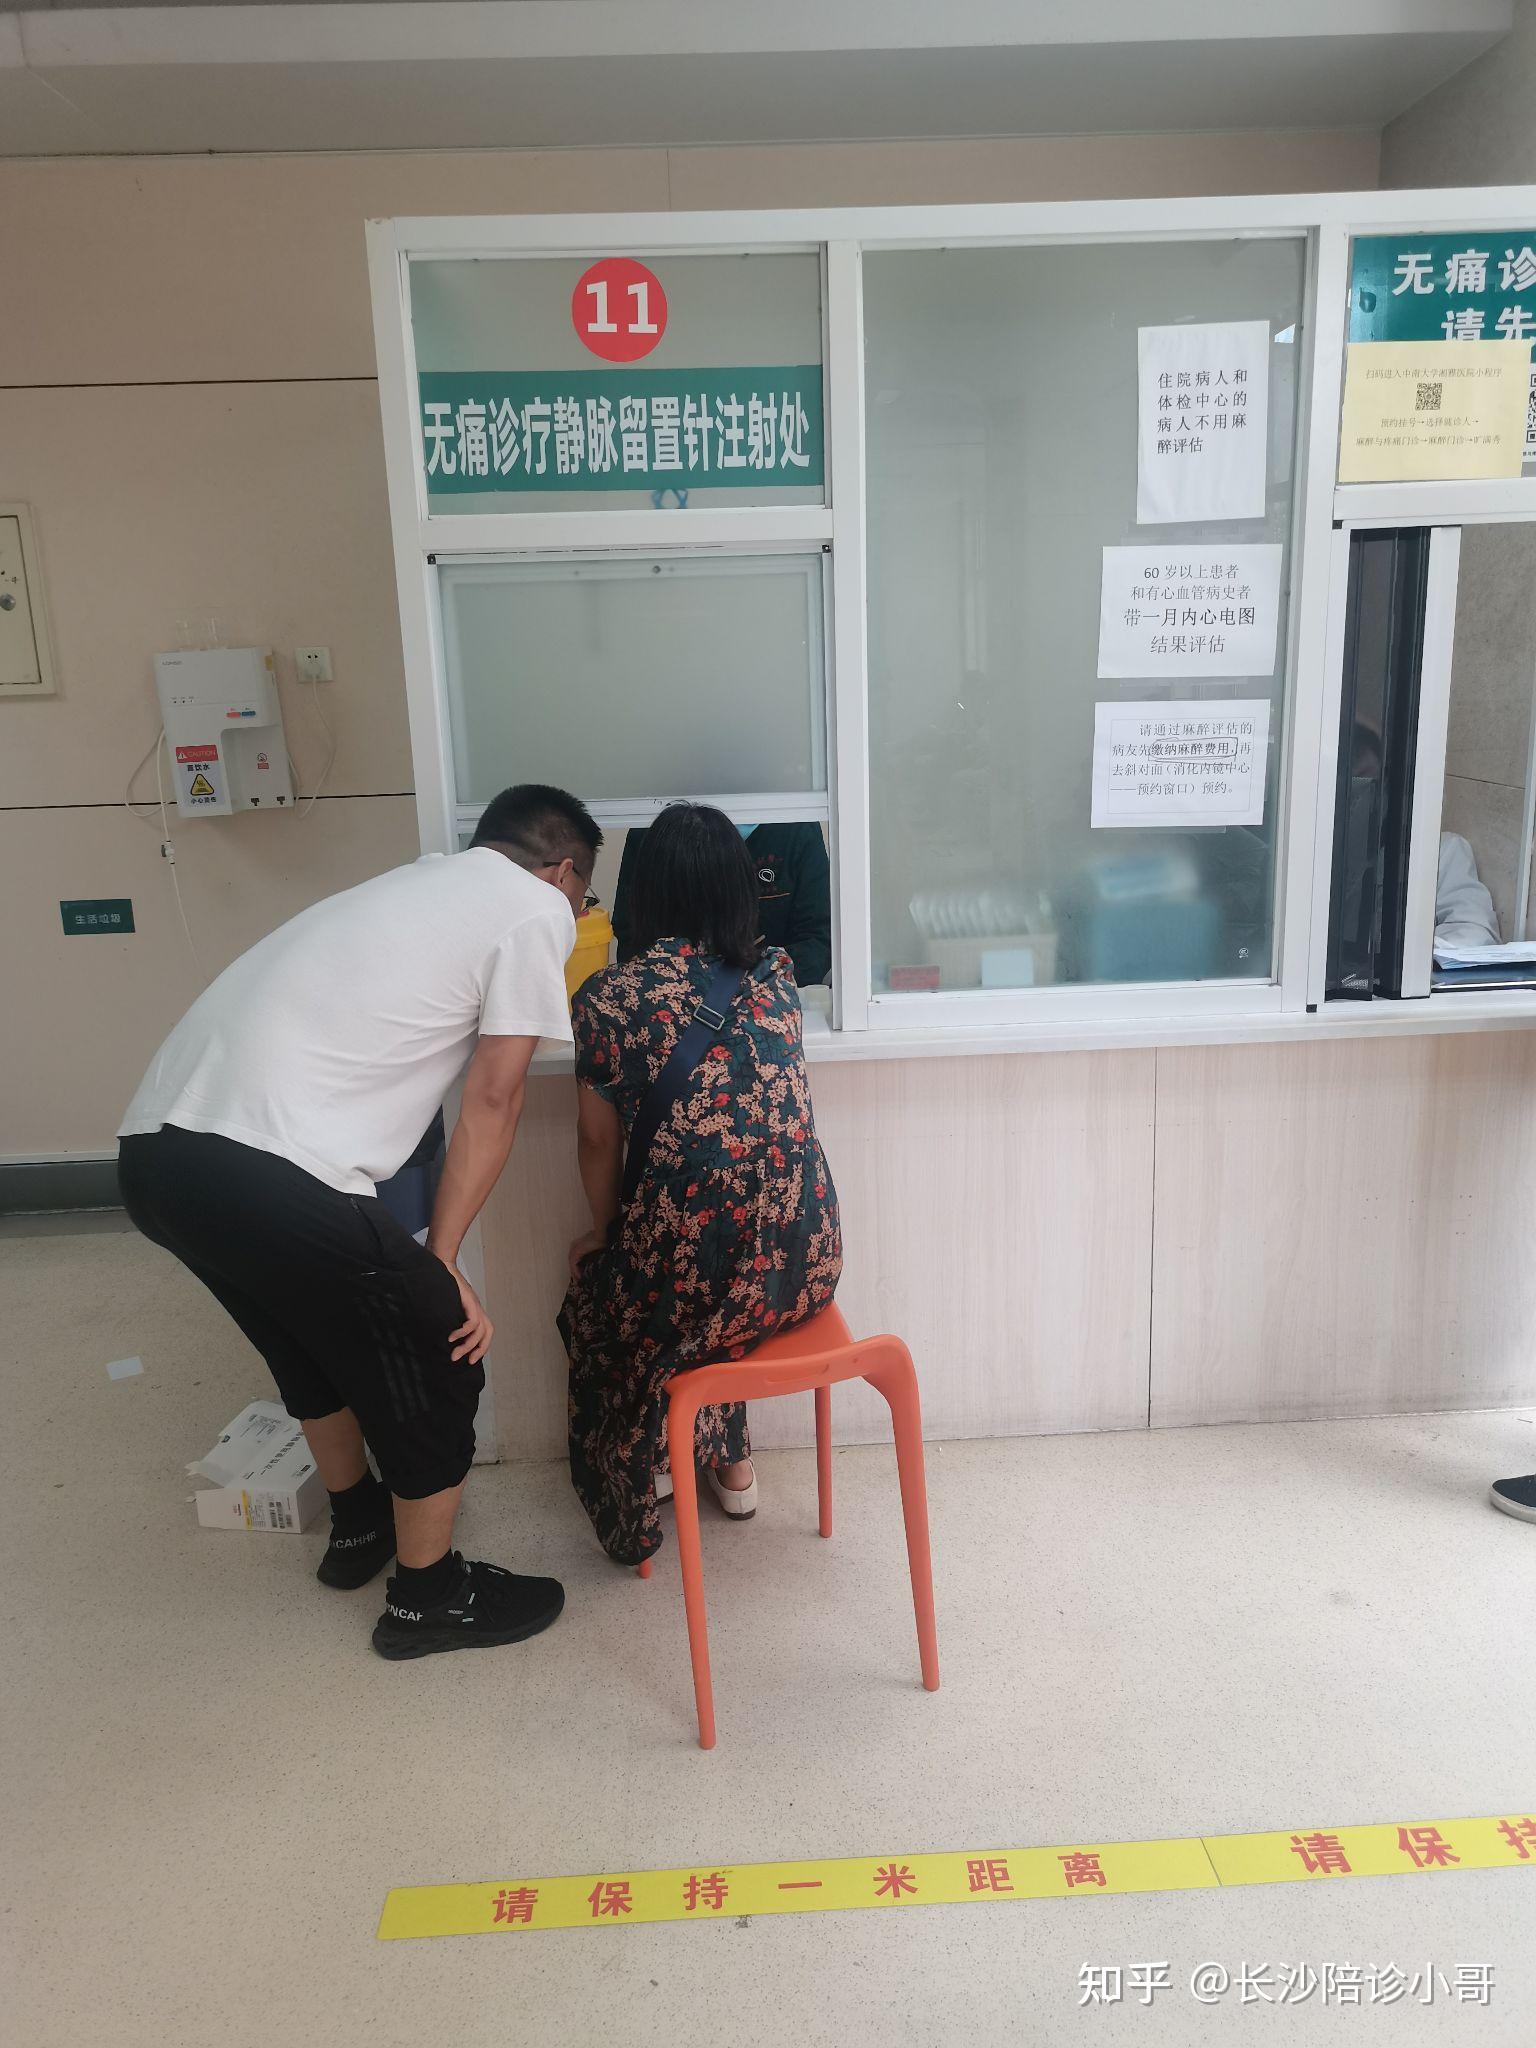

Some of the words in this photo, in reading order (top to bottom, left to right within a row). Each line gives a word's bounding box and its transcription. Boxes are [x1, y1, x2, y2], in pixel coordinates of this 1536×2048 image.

[1392, 246, 1536, 296] 无痛诊
[585, 280, 659, 335] 11
[1157, 368, 1248, 388] 住院病人和
[1157, 390, 1248, 411] 体检中心的
[1157, 412, 1248, 433] 病人不用麻
[424, 391, 811, 476] 无痛诊疗静脉留置针注射处
[1157, 436, 1203, 455] 醉评估
[1131, 585, 1251, 601] 和有心血管病史者
[1124, 607, 1255, 627] 带一月内心电图
[1150, 634, 1226, 654] 结果评估
[1139, 722, 1253, 737] 请通过麻醉评估的
[491, 1852, 1107, 1924] 请保持一米距离
